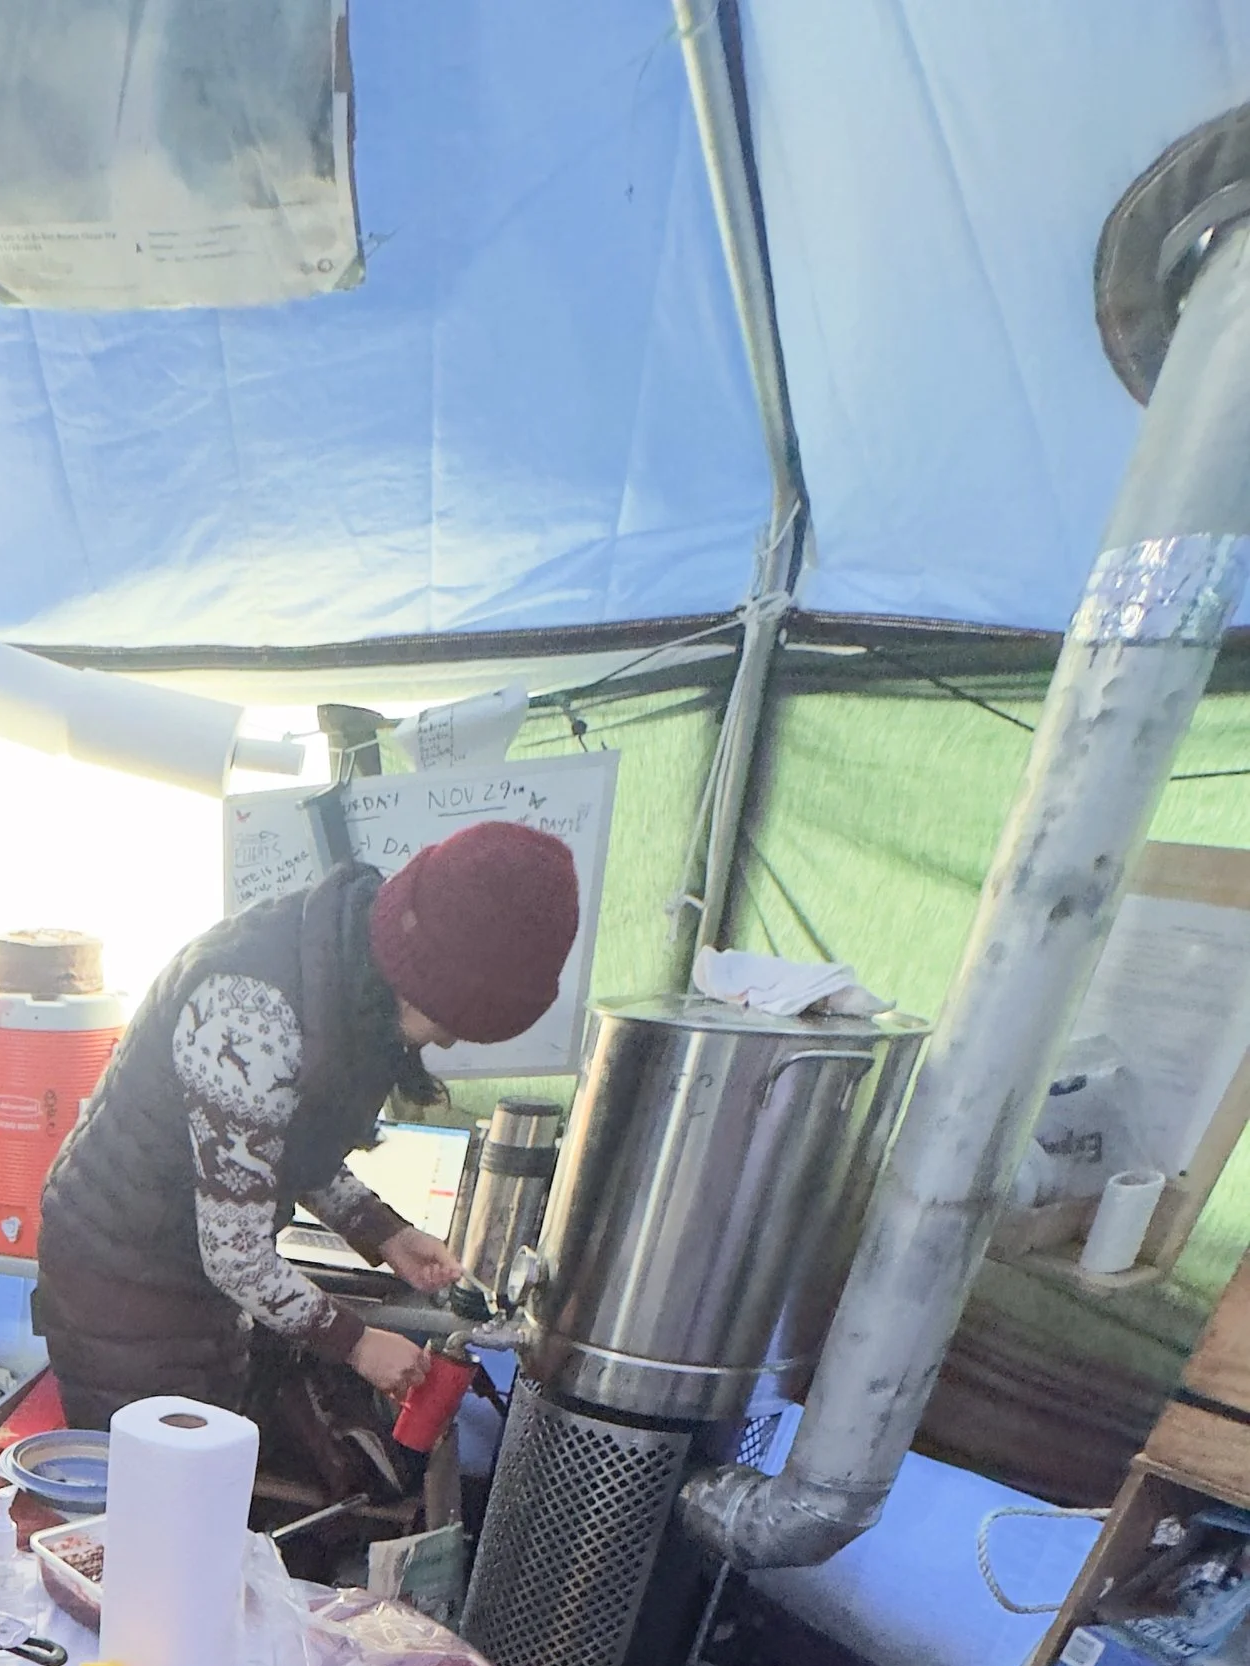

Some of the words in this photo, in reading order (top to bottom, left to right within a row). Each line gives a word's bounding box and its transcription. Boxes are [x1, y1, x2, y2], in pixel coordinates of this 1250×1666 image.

[343, 792, 399, 815] URDAY
[428, 787, 474, 809] NOV
[382, 837, 421, 858] DA
